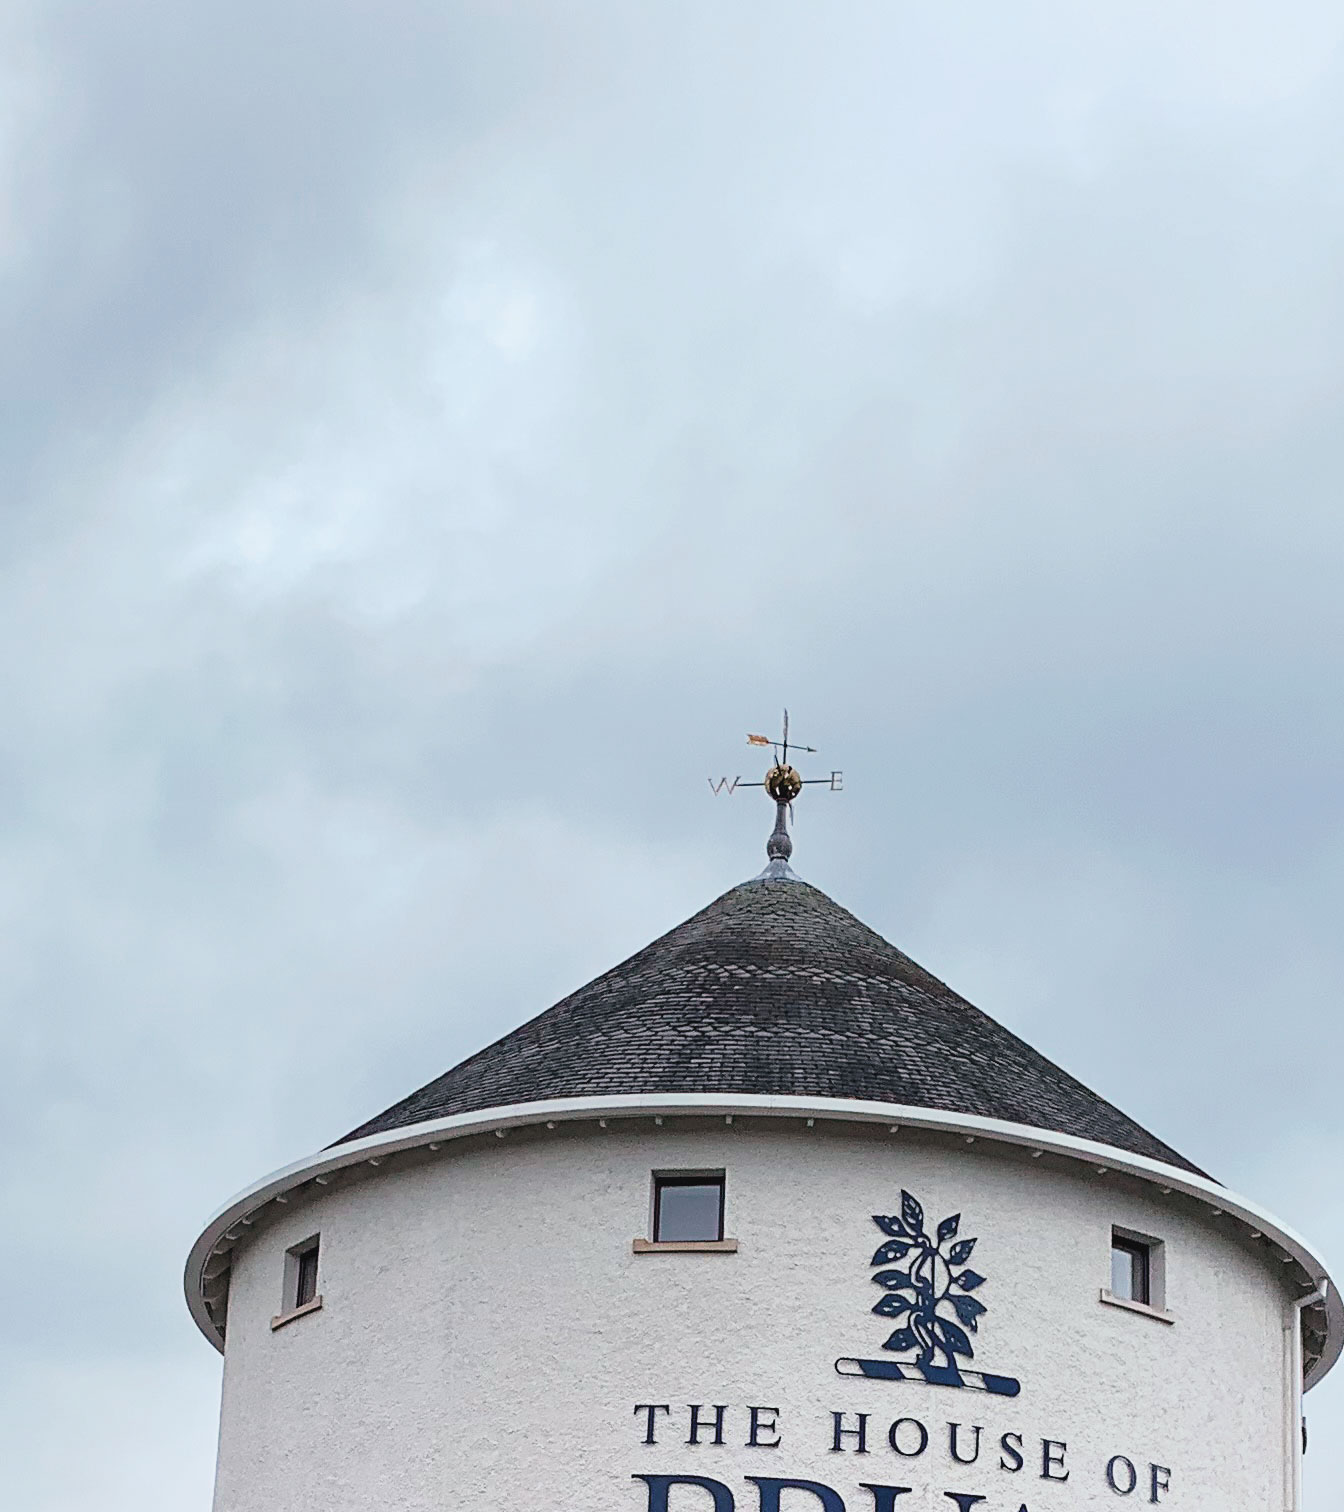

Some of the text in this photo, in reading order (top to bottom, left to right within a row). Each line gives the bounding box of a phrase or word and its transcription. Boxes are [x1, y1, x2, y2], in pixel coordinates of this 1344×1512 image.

[633, 1404, 1172, 1503] THE HOUSE OF
